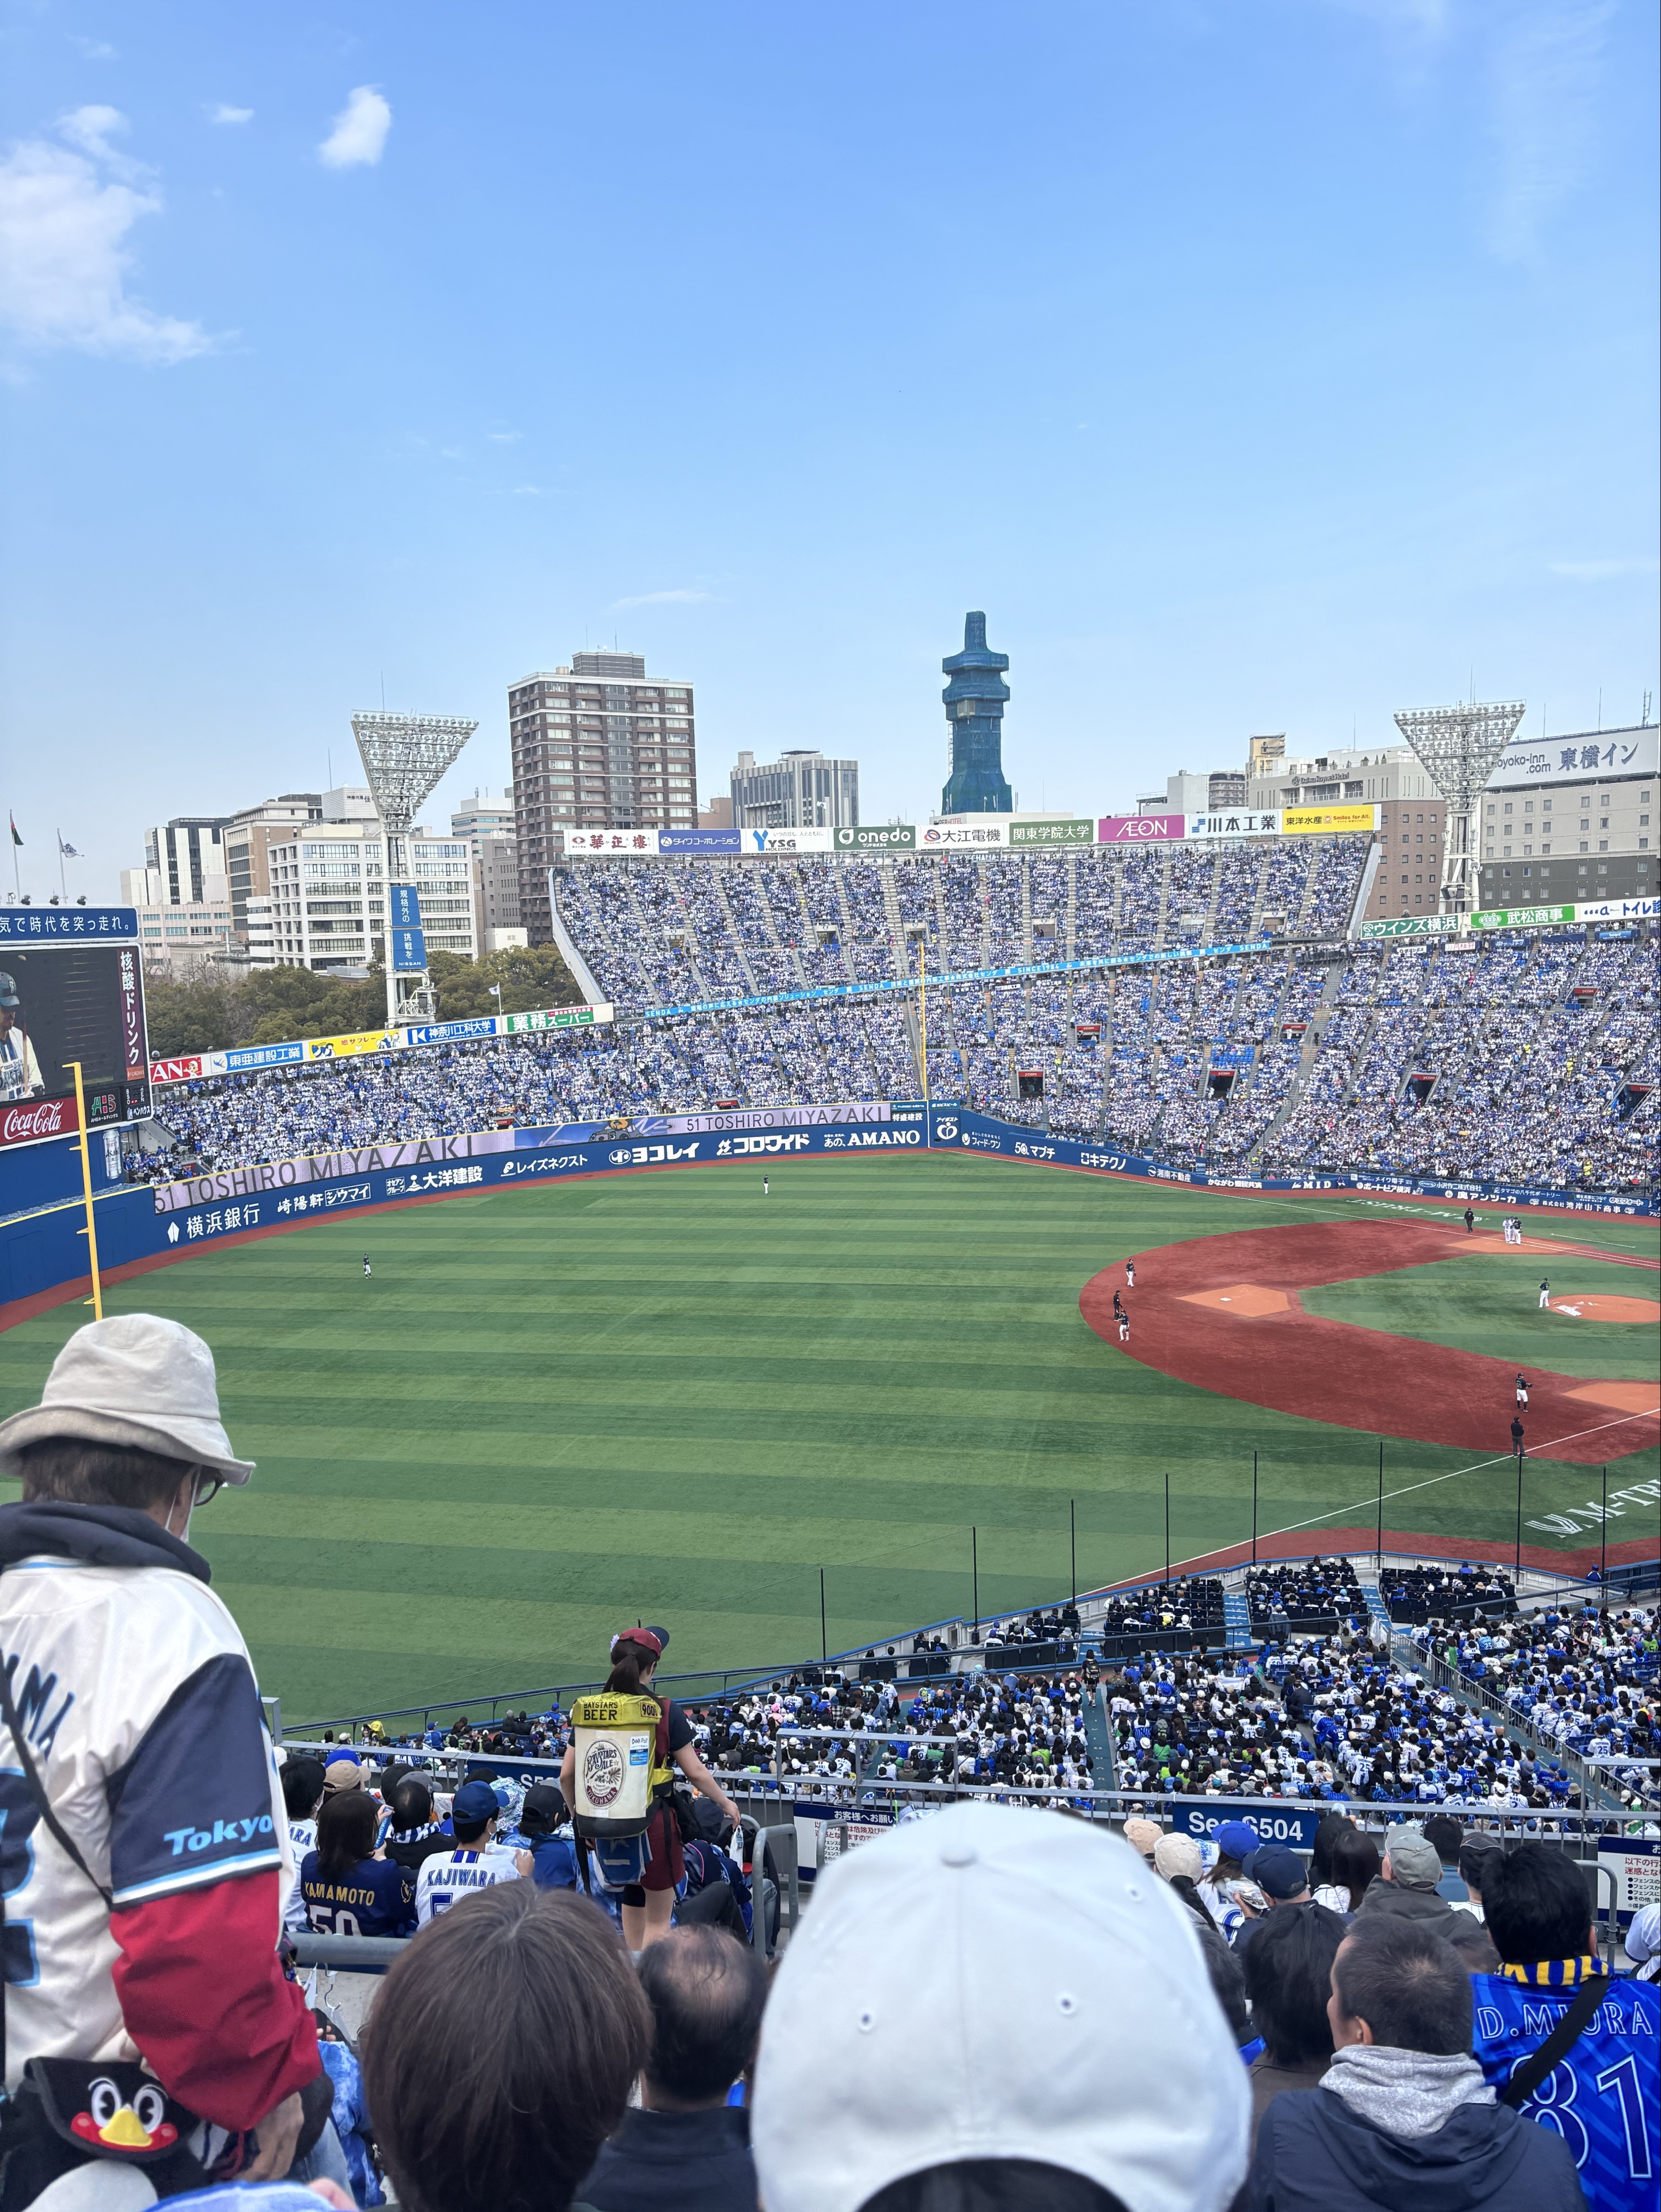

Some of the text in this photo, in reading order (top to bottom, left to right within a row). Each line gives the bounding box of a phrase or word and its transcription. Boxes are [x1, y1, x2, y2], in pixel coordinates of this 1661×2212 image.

[1496, 753, 1545, 769] oyoko-inn
[1558, 743, 1638, 771] 東横イン
[1526, 762, 1550, 774] .com
[1208, 815, 1277, 833] 川本工業
[1286, 816, 1322, 825] 東洋水産
[858, 828, 911, 843] onedo
[942, 828, 1001, 843] 大江電機
[1012, 825, 1090, 841] 関東学院大学
[768, 839, 796, 847] YSG
[400, 890, 410, 923] 規格外の
[0, 915, 130, 933] 気で時代を突っ走れ。
[1507, 908, 1563, 925] 武松商事
[1374, 915, 1457, 936] ウインズ横浜
[403, 933, 413, 959] 挑戦を
[1239, 943, 1267, 951] SENDA
[120, 951, 140, 1066] 核酸ドリンク
[645, 1009, 671, 1017] SENDA
[429, 1020, 491, 1039] 神奈川工科大学
[513, 1012, 590, 1031] 業務スーパー
[229, 1046, 301, 1068] 東亜建設工業
[133, 1105, 150, 1116] ペンハウス
[687, 1106, 882, 1131] 51 TOSHIRO MIYAZAKI
[4, 1101, 63, 1140] Coca-Cola
[733, 1134, 810, 1154] コロワイド
[824, 1138, 847, 1148] あの、
[847, 1130, 920, 1146] AMANO
[972, 1137, 1001, 1149] フィード・ワン
[632, 1142, 700, 1163] ヨコレイ
[1030, 1146, 1055, 1160] マブチ
[517, 1154, 588, 1174] レイズネクスト
[154, 1135, 472, 1213] 51 TOSHIRO MIYAZAKI
[423, 1166, 483, 1189] 大洋建設
[1156, 1168, 1192, 1183] 湘南不動産
[1375, 1176, 1404, 1184] メイワ電子
[386, 1179, 404, 1187] オセアン
[1208, 1179, 1262, 1189] かながわ県民共済
[1303, 1180, 1332, 1189] MID
[277, 1193, 324, 1214] 崎陽軒
[1566, 1201, 1621, 1214] 湾岸山下商事
[186, 1203, 260, 1239] 横浜銀行
[583, 1709, 618, 1721] BEER
[642, 1704, 655, 1717] 900
[1337, 1732, 1345, 1740] 5
[1598, 1746, 1607, 1754] 25
[586, 1749, 617, 1773] BAYSTARS
[602, 1760, 613, 1770] ALE
[1359, 1763, 1370, 1772] 25
[587, 1789, 617, 1805] YOKOHAMA
[834, 1810, 895, 1824] お客様へお願い
[164, 1815, 272, 1855] Tokyo
[1242, 1816, 1303, 1842] S504
[1625, 1857, 1660, 1868] 以下の行
[427, 1869, 495, 1887] KAJIWARA
[305, 1881, 375, 1907] YAMAMOTO
[309, 1904, 363, 1936] 50
[1510, 2053, 1652, 2179] 81
